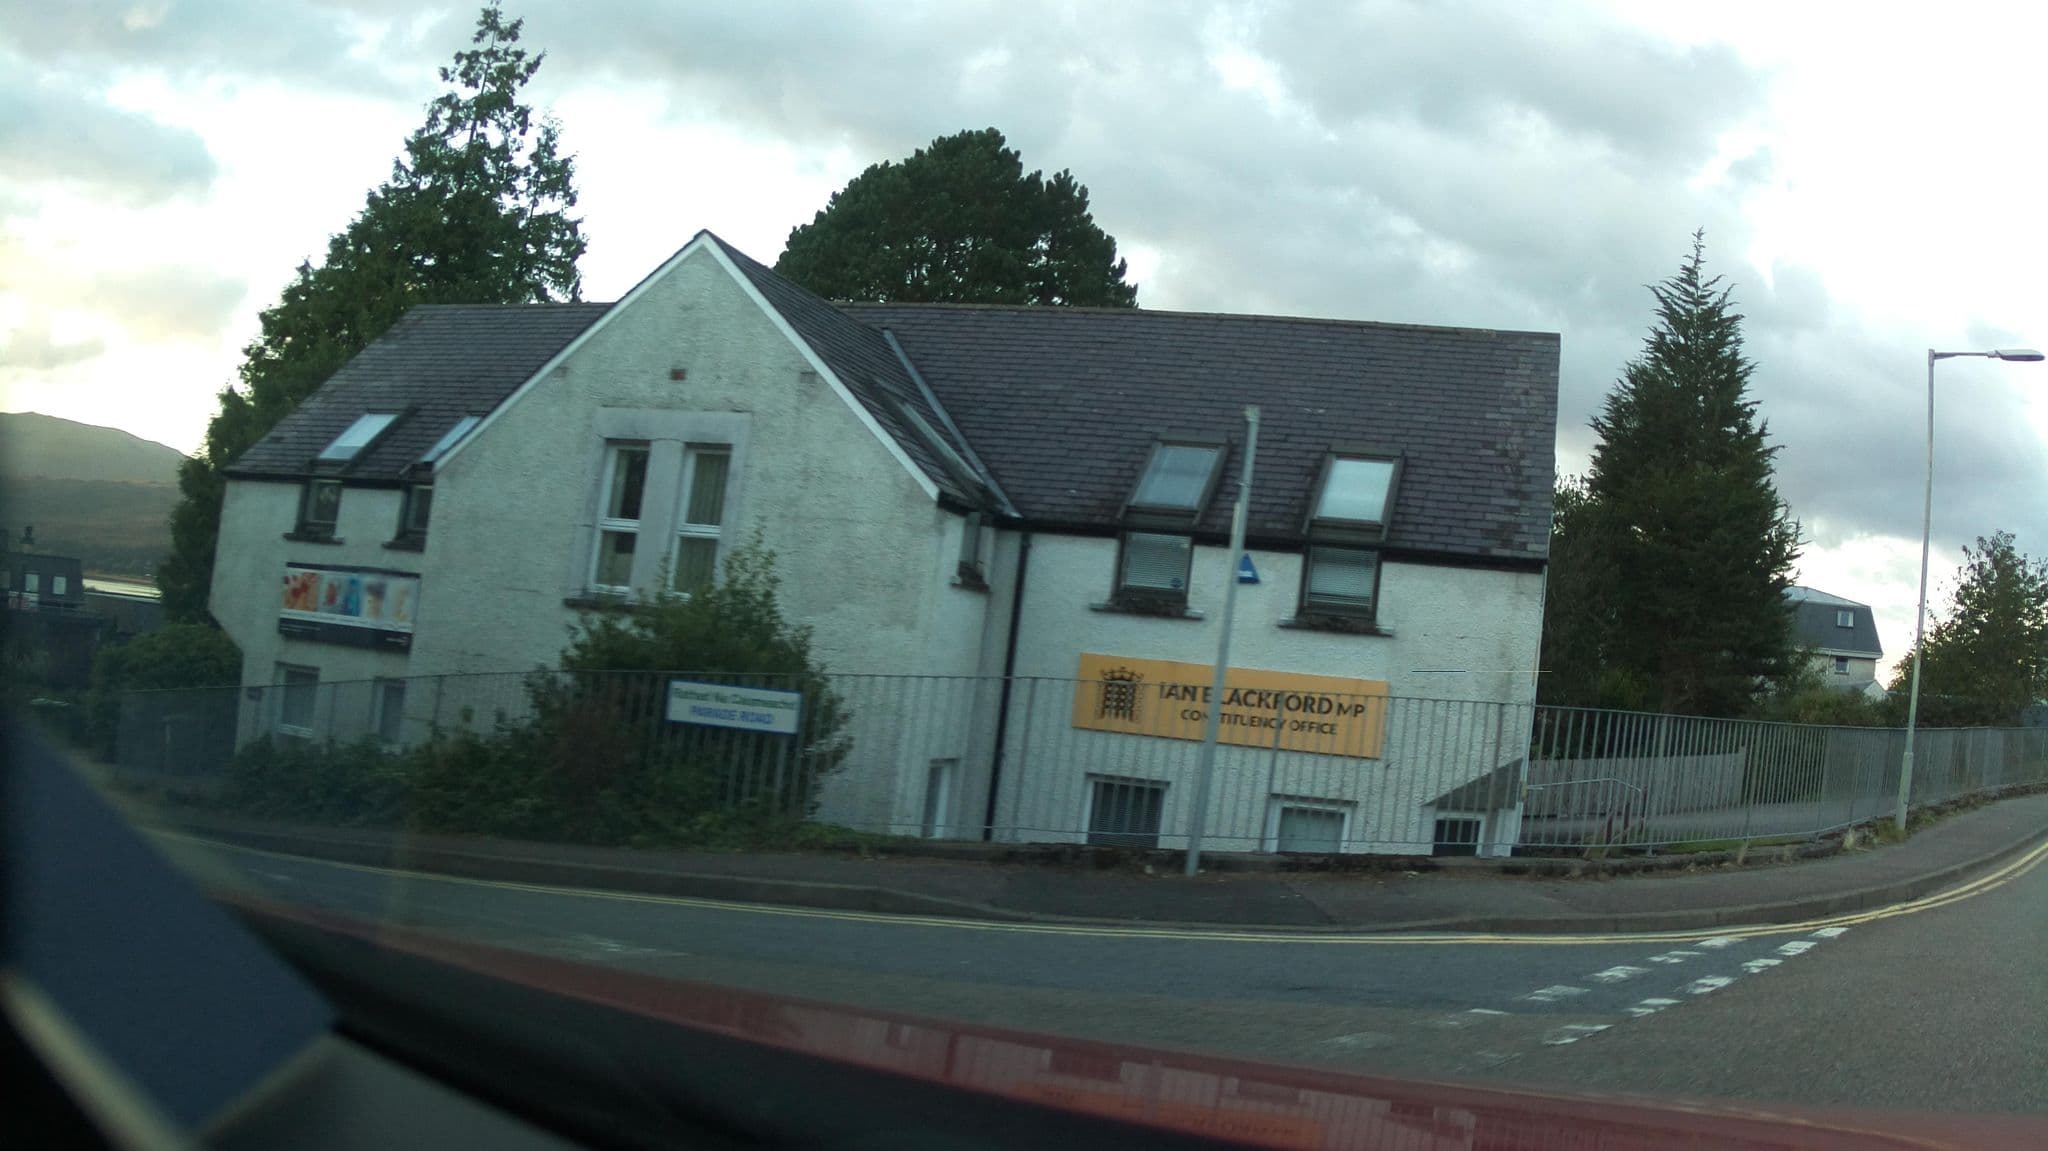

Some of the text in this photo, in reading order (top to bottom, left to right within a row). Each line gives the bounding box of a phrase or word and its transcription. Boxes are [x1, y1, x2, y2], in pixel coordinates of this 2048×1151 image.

[1159, 683, 1366, 718] IAN BACKFORD MP
[691, 705, 775, 725] PARADE ROAD
[1180, 708, 1339, 735] CONTITUENCY OFFICE
